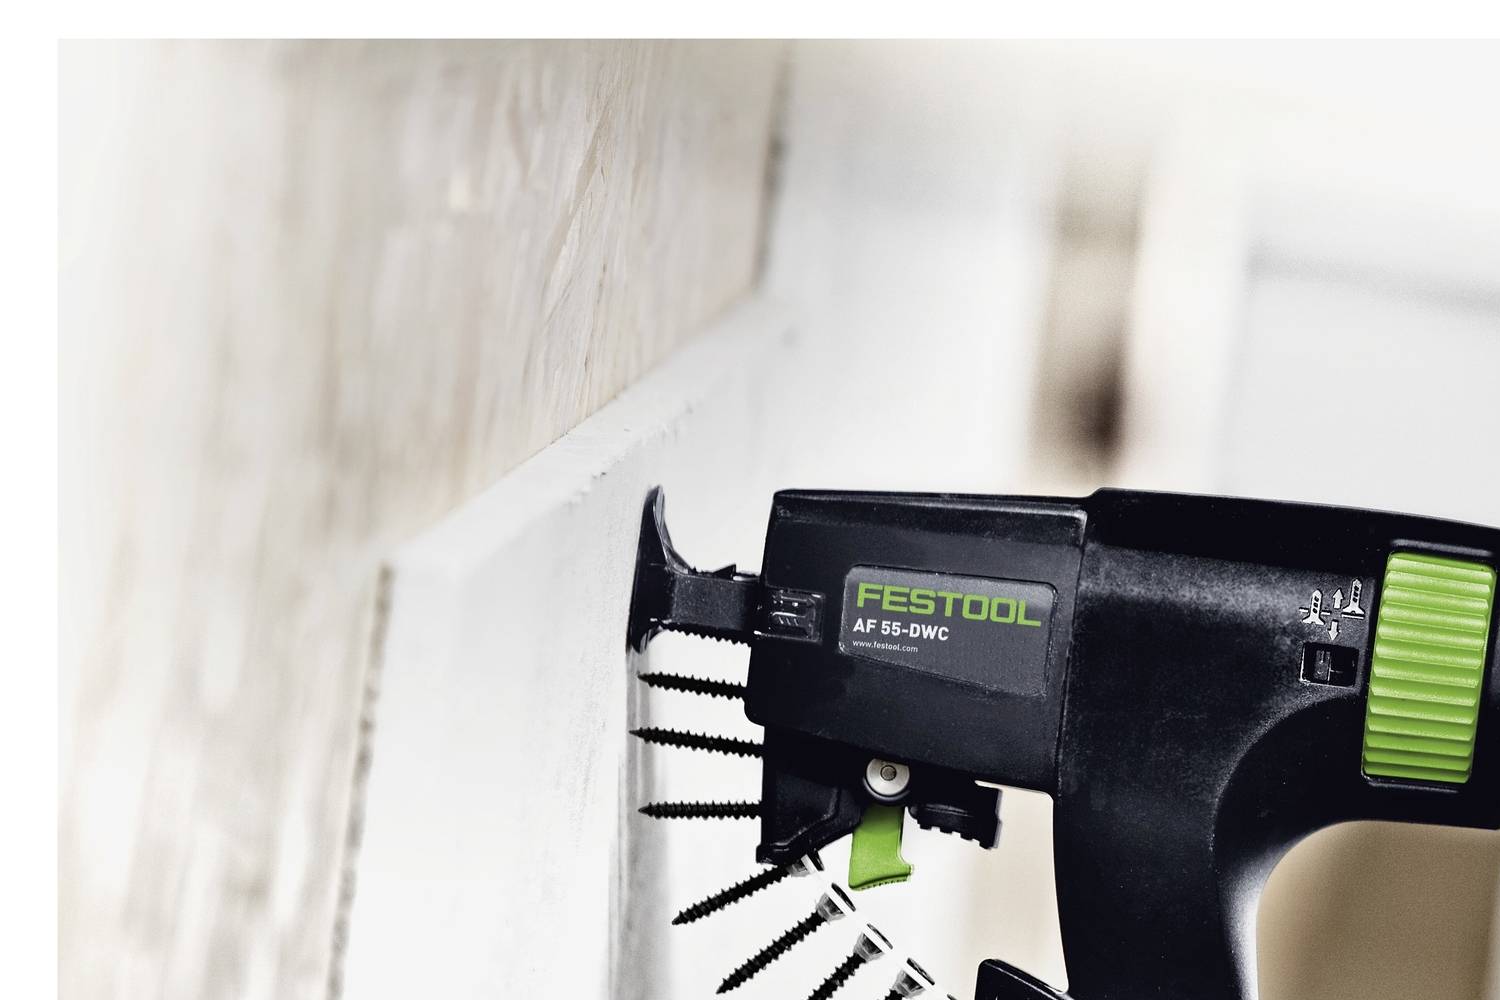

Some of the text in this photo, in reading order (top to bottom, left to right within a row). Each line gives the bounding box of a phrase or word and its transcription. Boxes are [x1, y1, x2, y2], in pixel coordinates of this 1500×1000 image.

[857, 582, 1042, 627] FESTOOL
[852, 617, 950, 641] AF 55-DWC
[852, 639, 919, 653] www.festool.com
